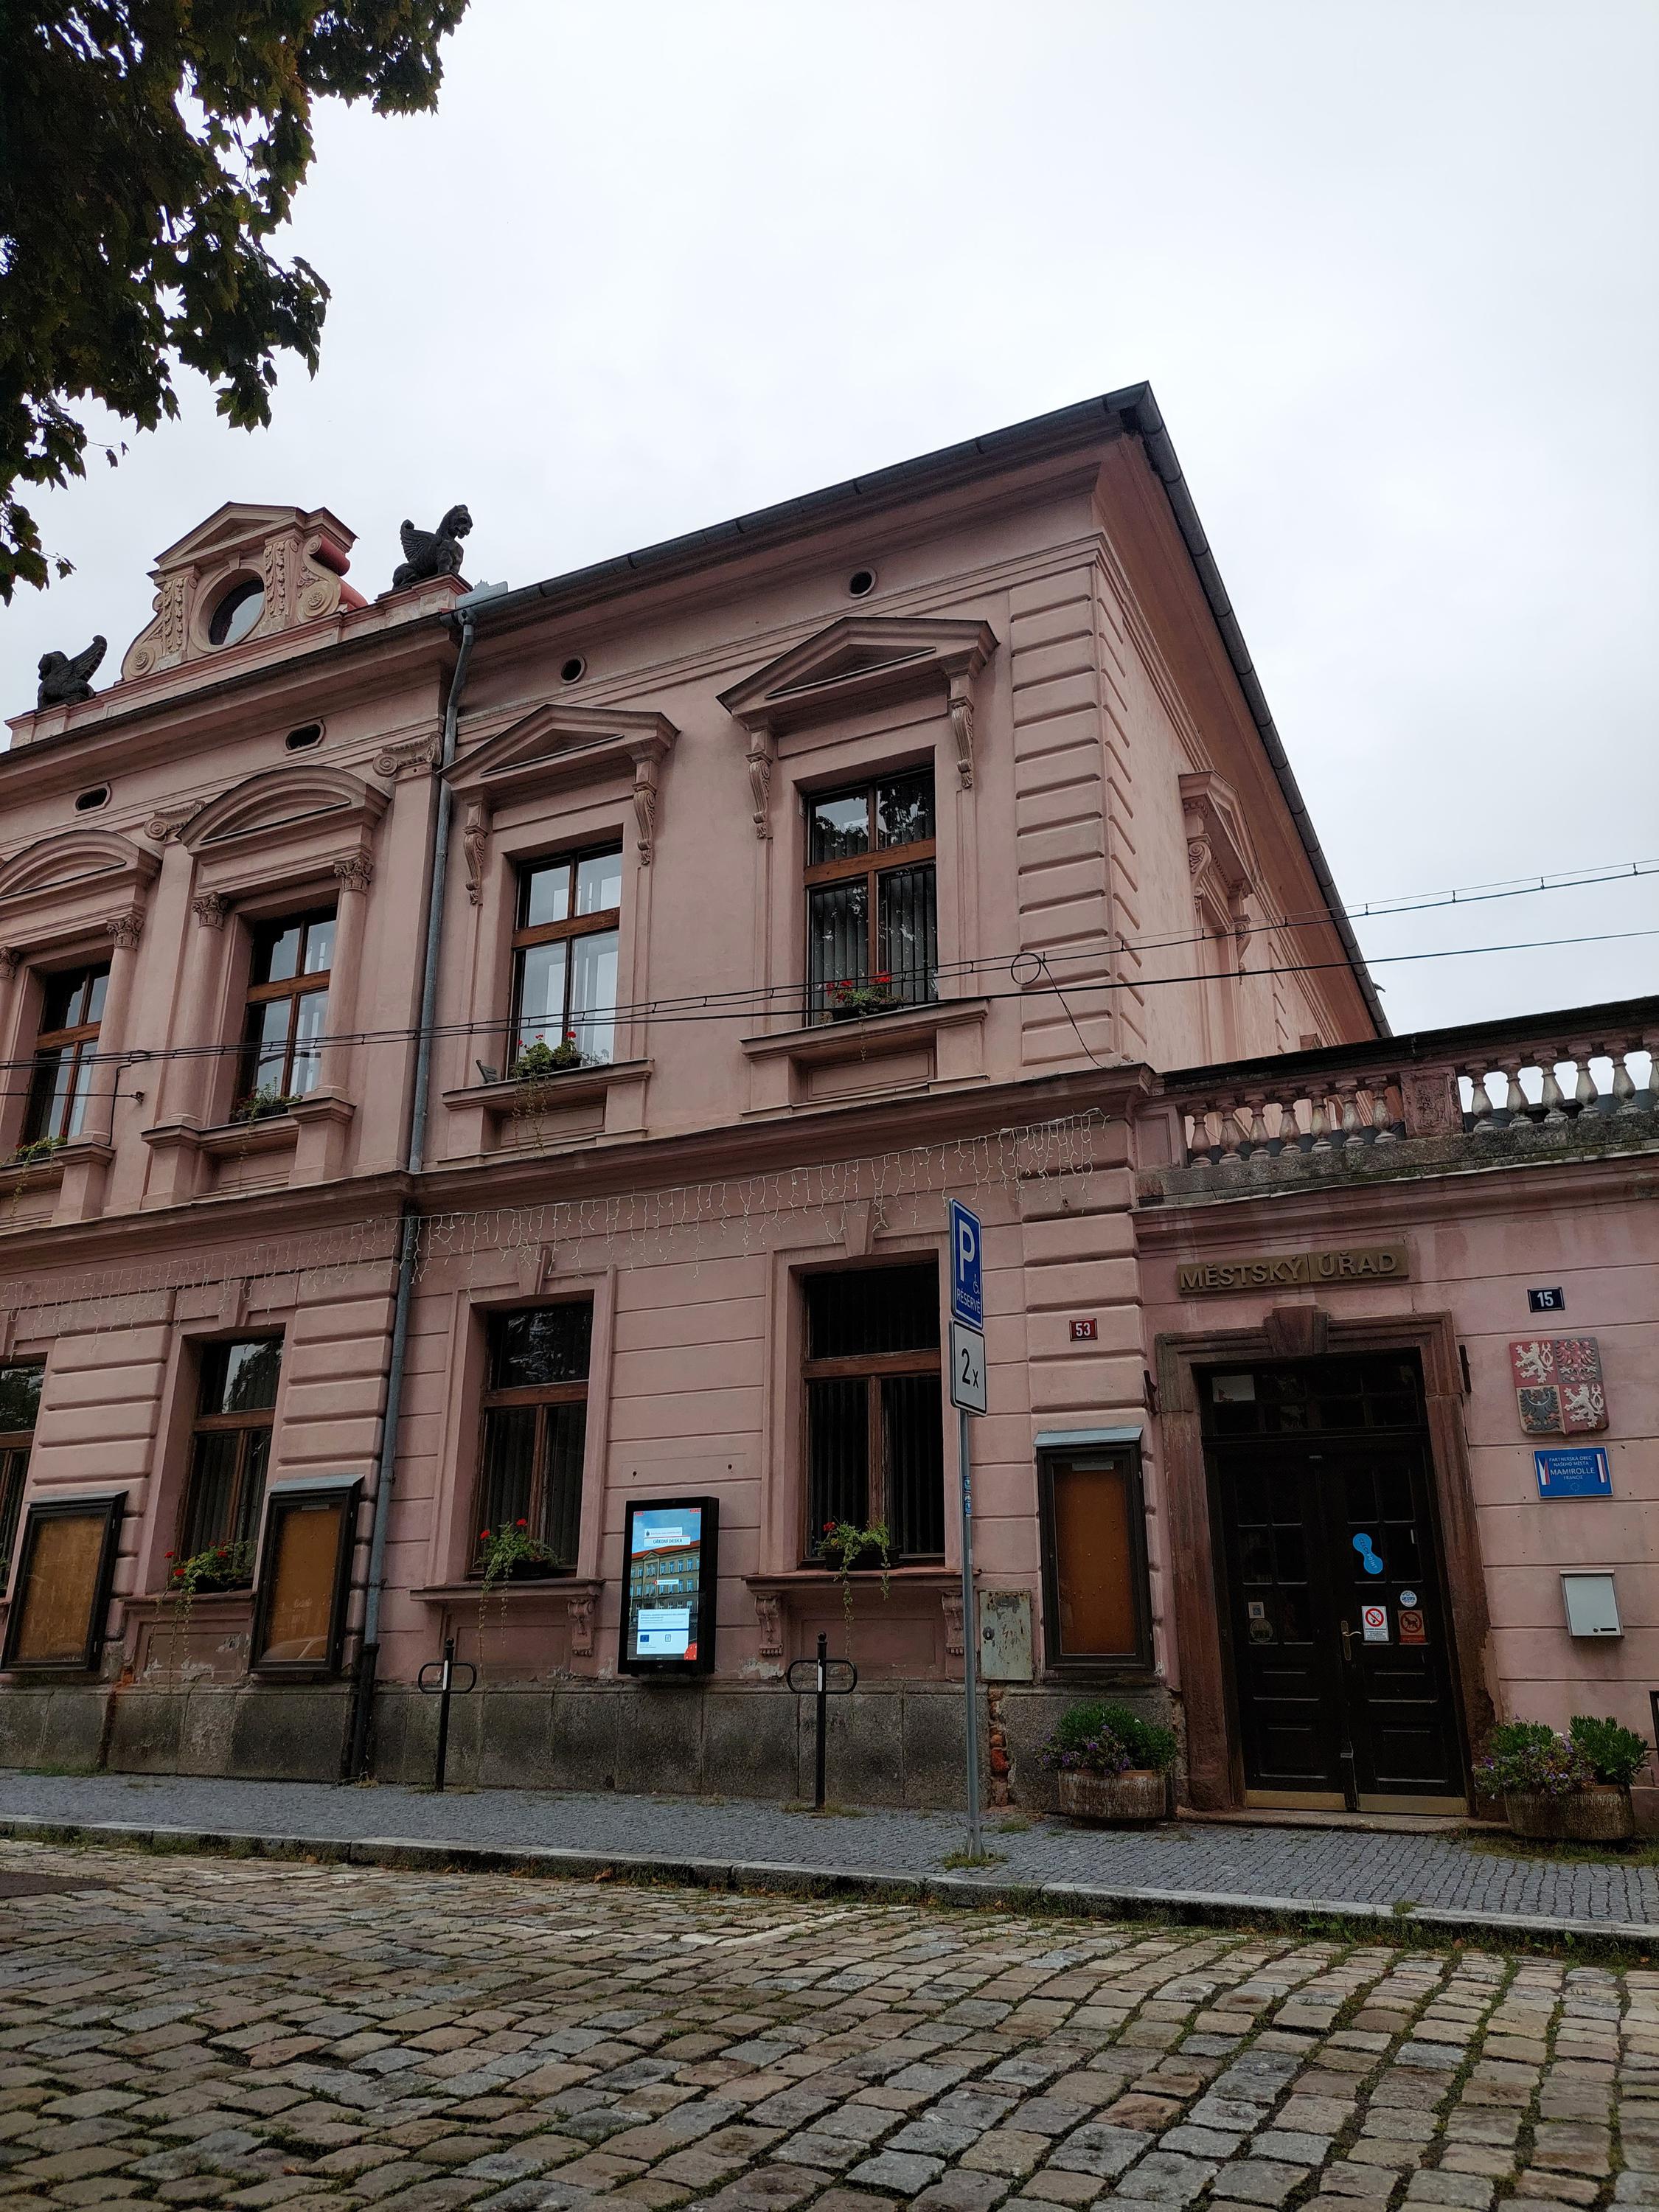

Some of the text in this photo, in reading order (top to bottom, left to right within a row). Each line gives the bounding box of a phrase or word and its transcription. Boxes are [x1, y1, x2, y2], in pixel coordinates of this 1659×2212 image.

[959, 1219, 975, 1281] P
[1179, 1251, 1397, 1289] MĚSTSKÝ ÚŘAD
[956, 1288, 981, 1314] RÉSERVÉ
[1537, 1291, 1554, 1307] 15
[1076, 1323, 1091, 1337] 53
[1550, 1467, 1596, 1475] MAMIROLLE
